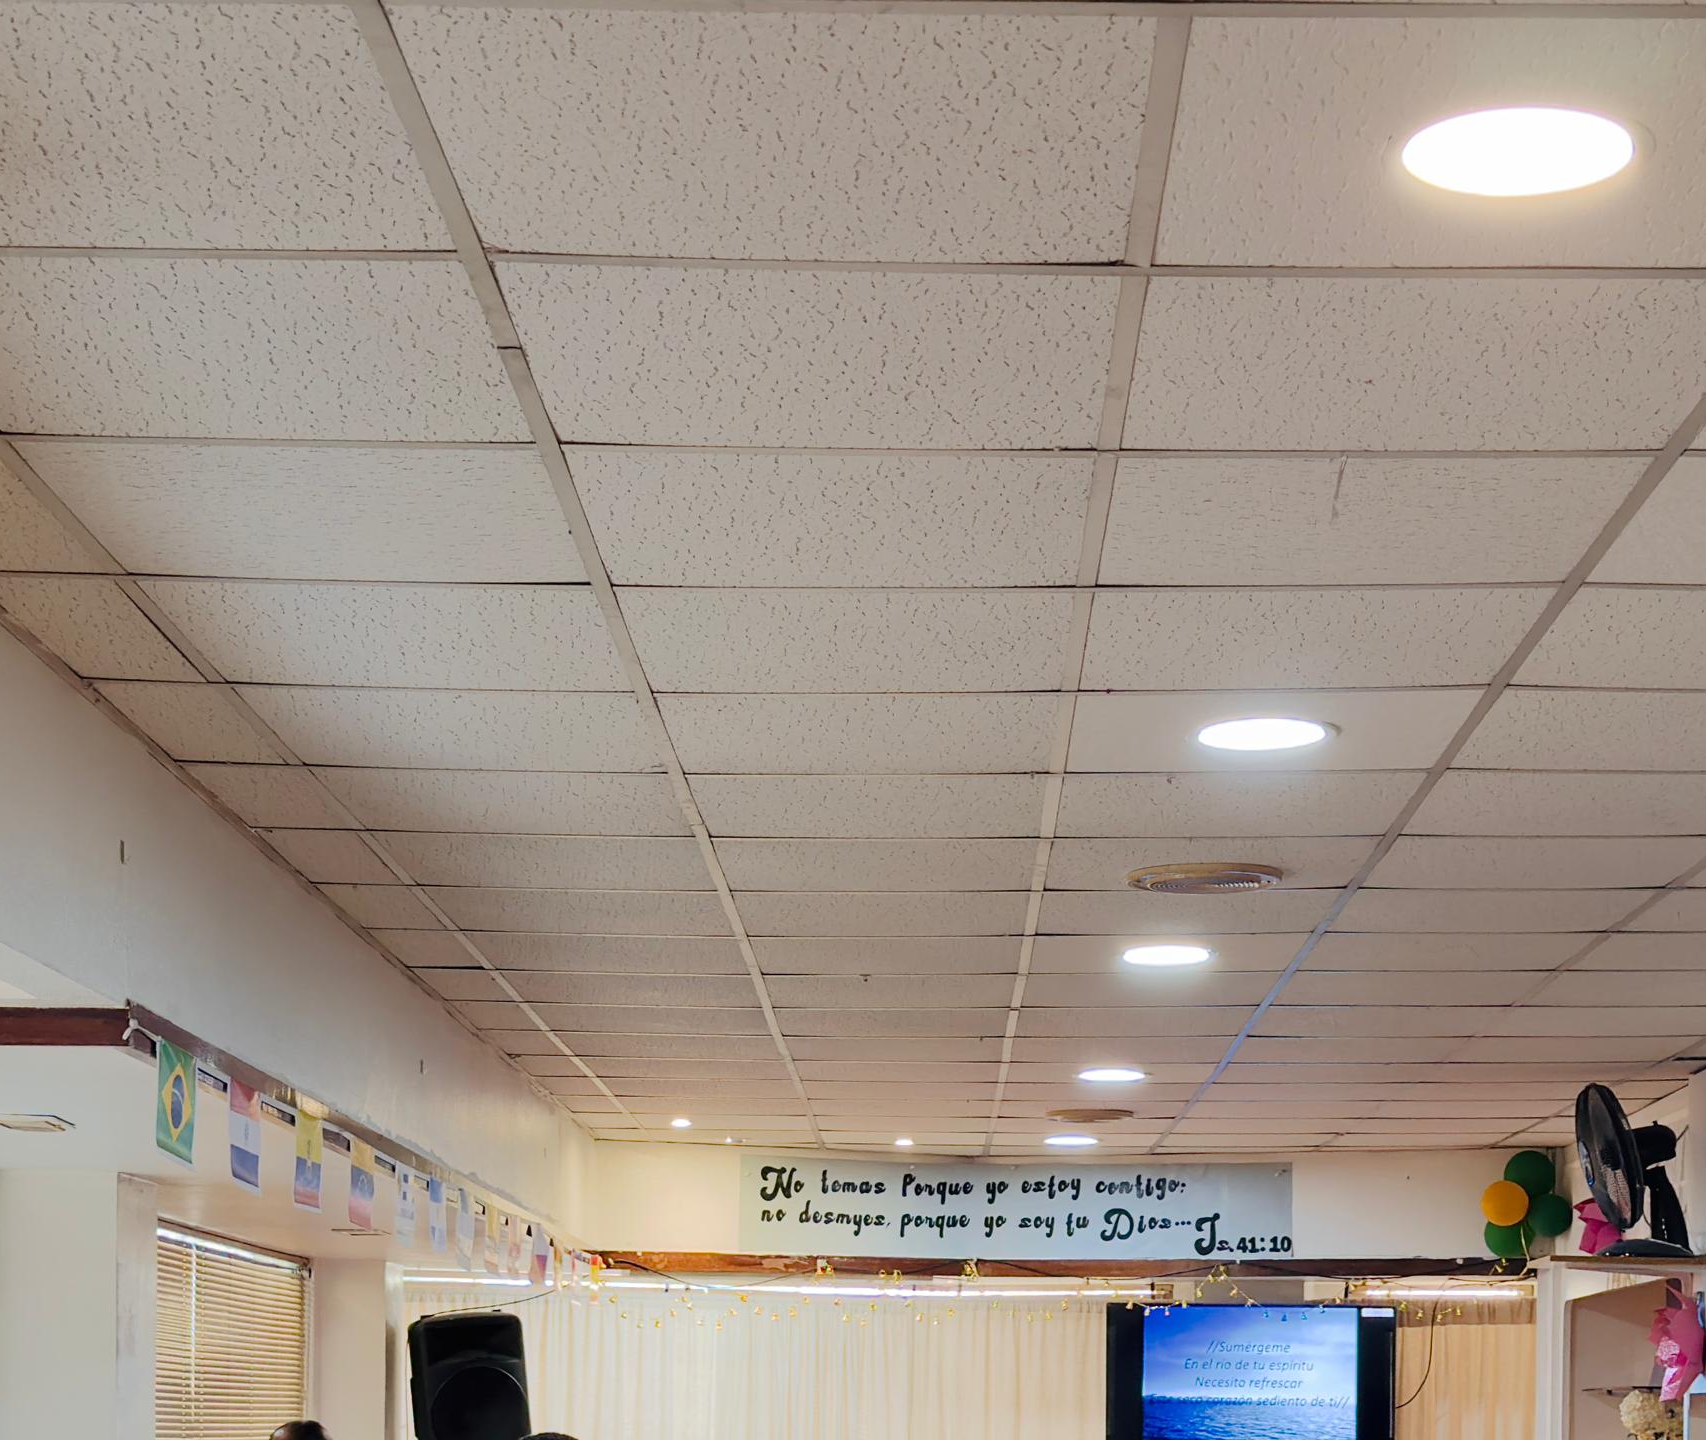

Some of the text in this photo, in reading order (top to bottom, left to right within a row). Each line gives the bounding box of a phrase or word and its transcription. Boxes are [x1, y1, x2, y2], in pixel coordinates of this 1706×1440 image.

[760, 1165, 1187, 1205] No temas Porque yo estoy contigo:
[761, 1208, 787, 1222] no
[899, 1213, 971, 1239] porque
[983, 1215, 1007, 1238] yo
[1018, 1215, 1055, 1238] soy
[1066, 1212, 1090, 1237] tu
[1236, 1235, 1293, 1254] 41:10
[1184, 1358, 1199, 1371] En
[1202, 1359, 1213, 1371] el
[1235, 1360, 1250, 1371] de
[1253, 1361, 1266, 1371] tu
[1195, 1377, 1304, 1391] Necesito refrescar
[1256, 1395, 1308, 1408] sediento
[1310, 1396, 1326, 1408] de
